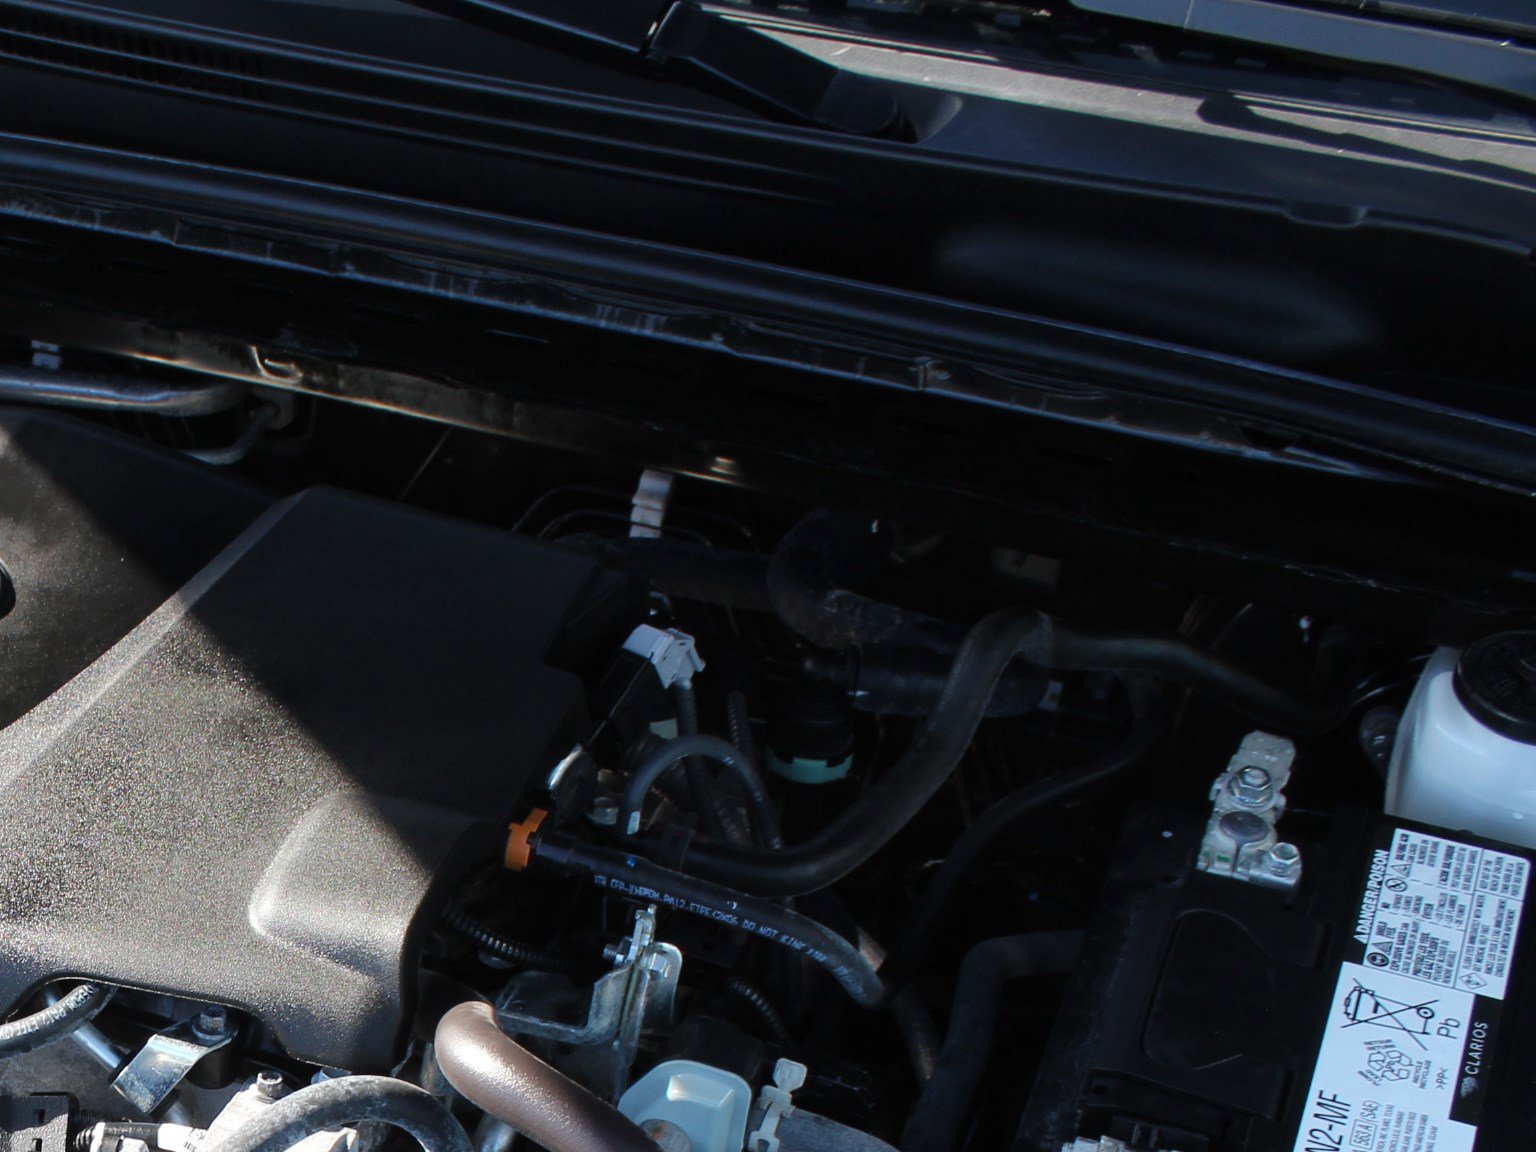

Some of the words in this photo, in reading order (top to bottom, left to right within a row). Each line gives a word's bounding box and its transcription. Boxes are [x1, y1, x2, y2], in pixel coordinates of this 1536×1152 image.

[1360, 849, 1389, 935] DANGER/POISON
[1436, 1018, 1460, 1039] Pb
[1464, 1021, 1488, 1075] CLARIOS
